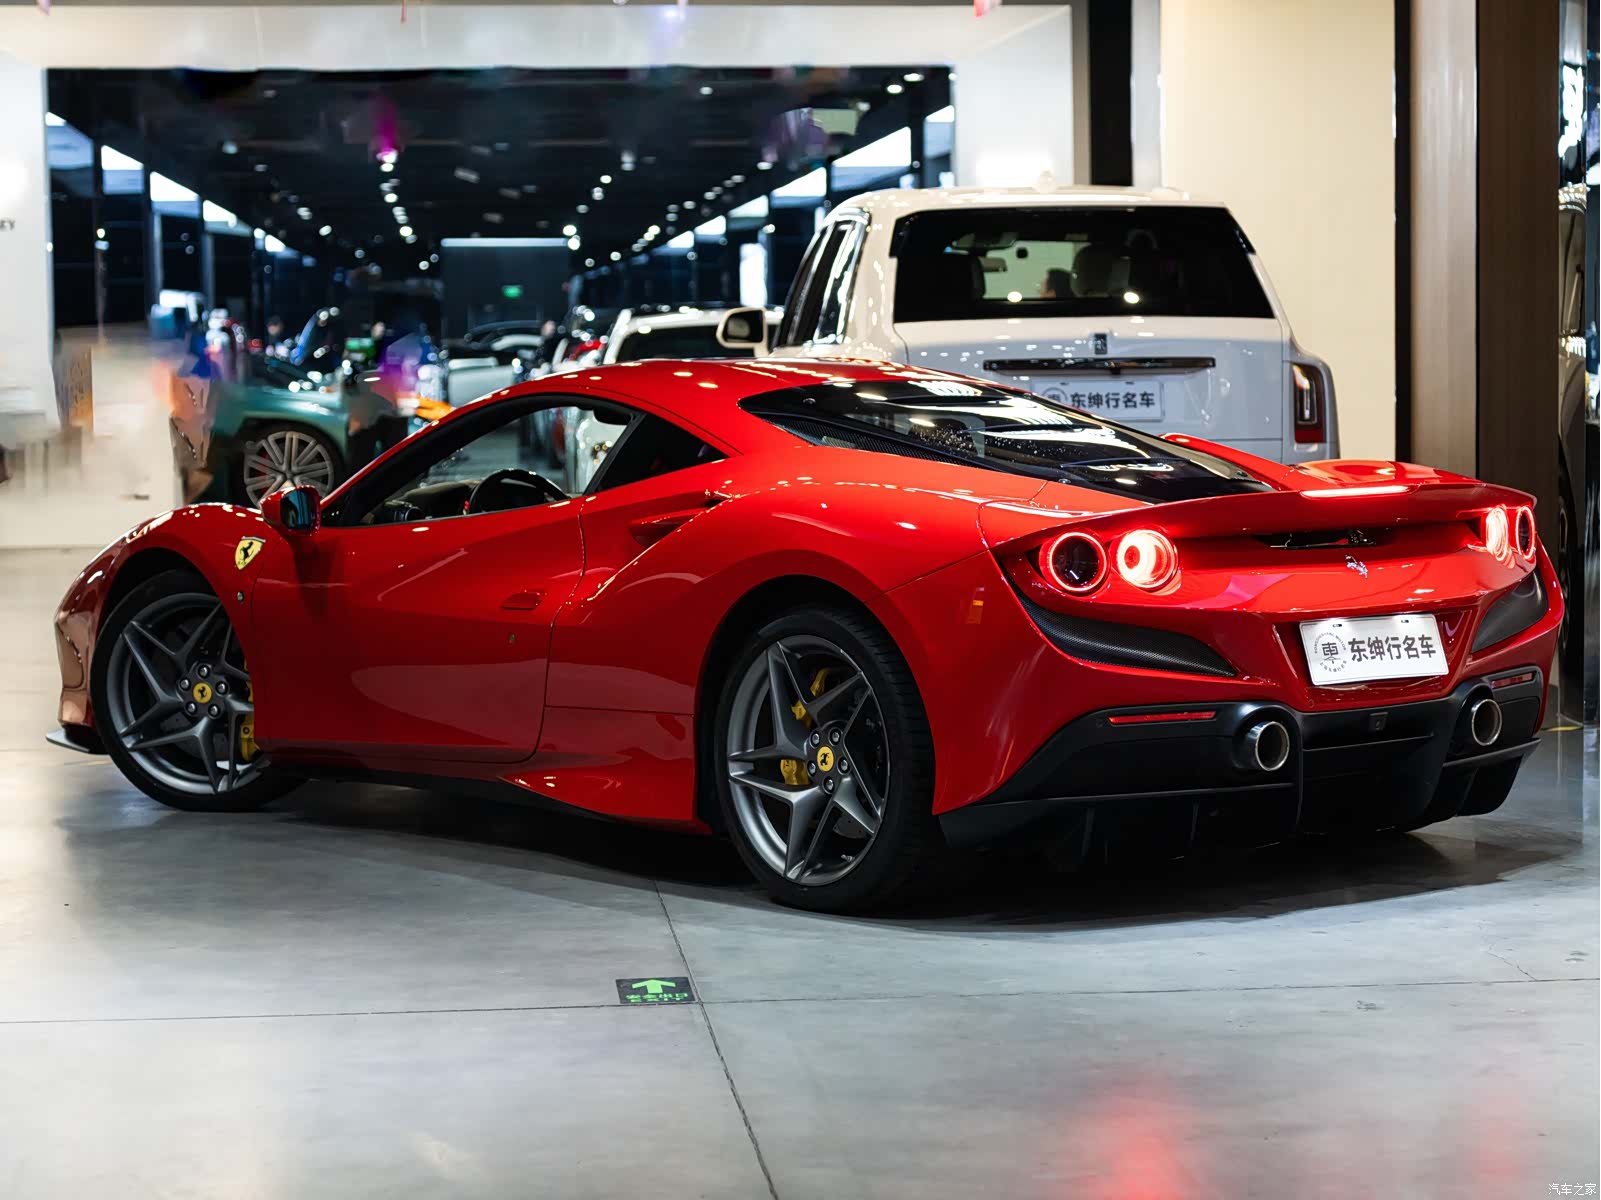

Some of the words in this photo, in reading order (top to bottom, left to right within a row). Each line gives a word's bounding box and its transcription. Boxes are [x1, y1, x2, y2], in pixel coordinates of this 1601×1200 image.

[1070, 391, 1155, 409] 东绅行名车
[1348, 634, 1437, 662] 东绅行名车
